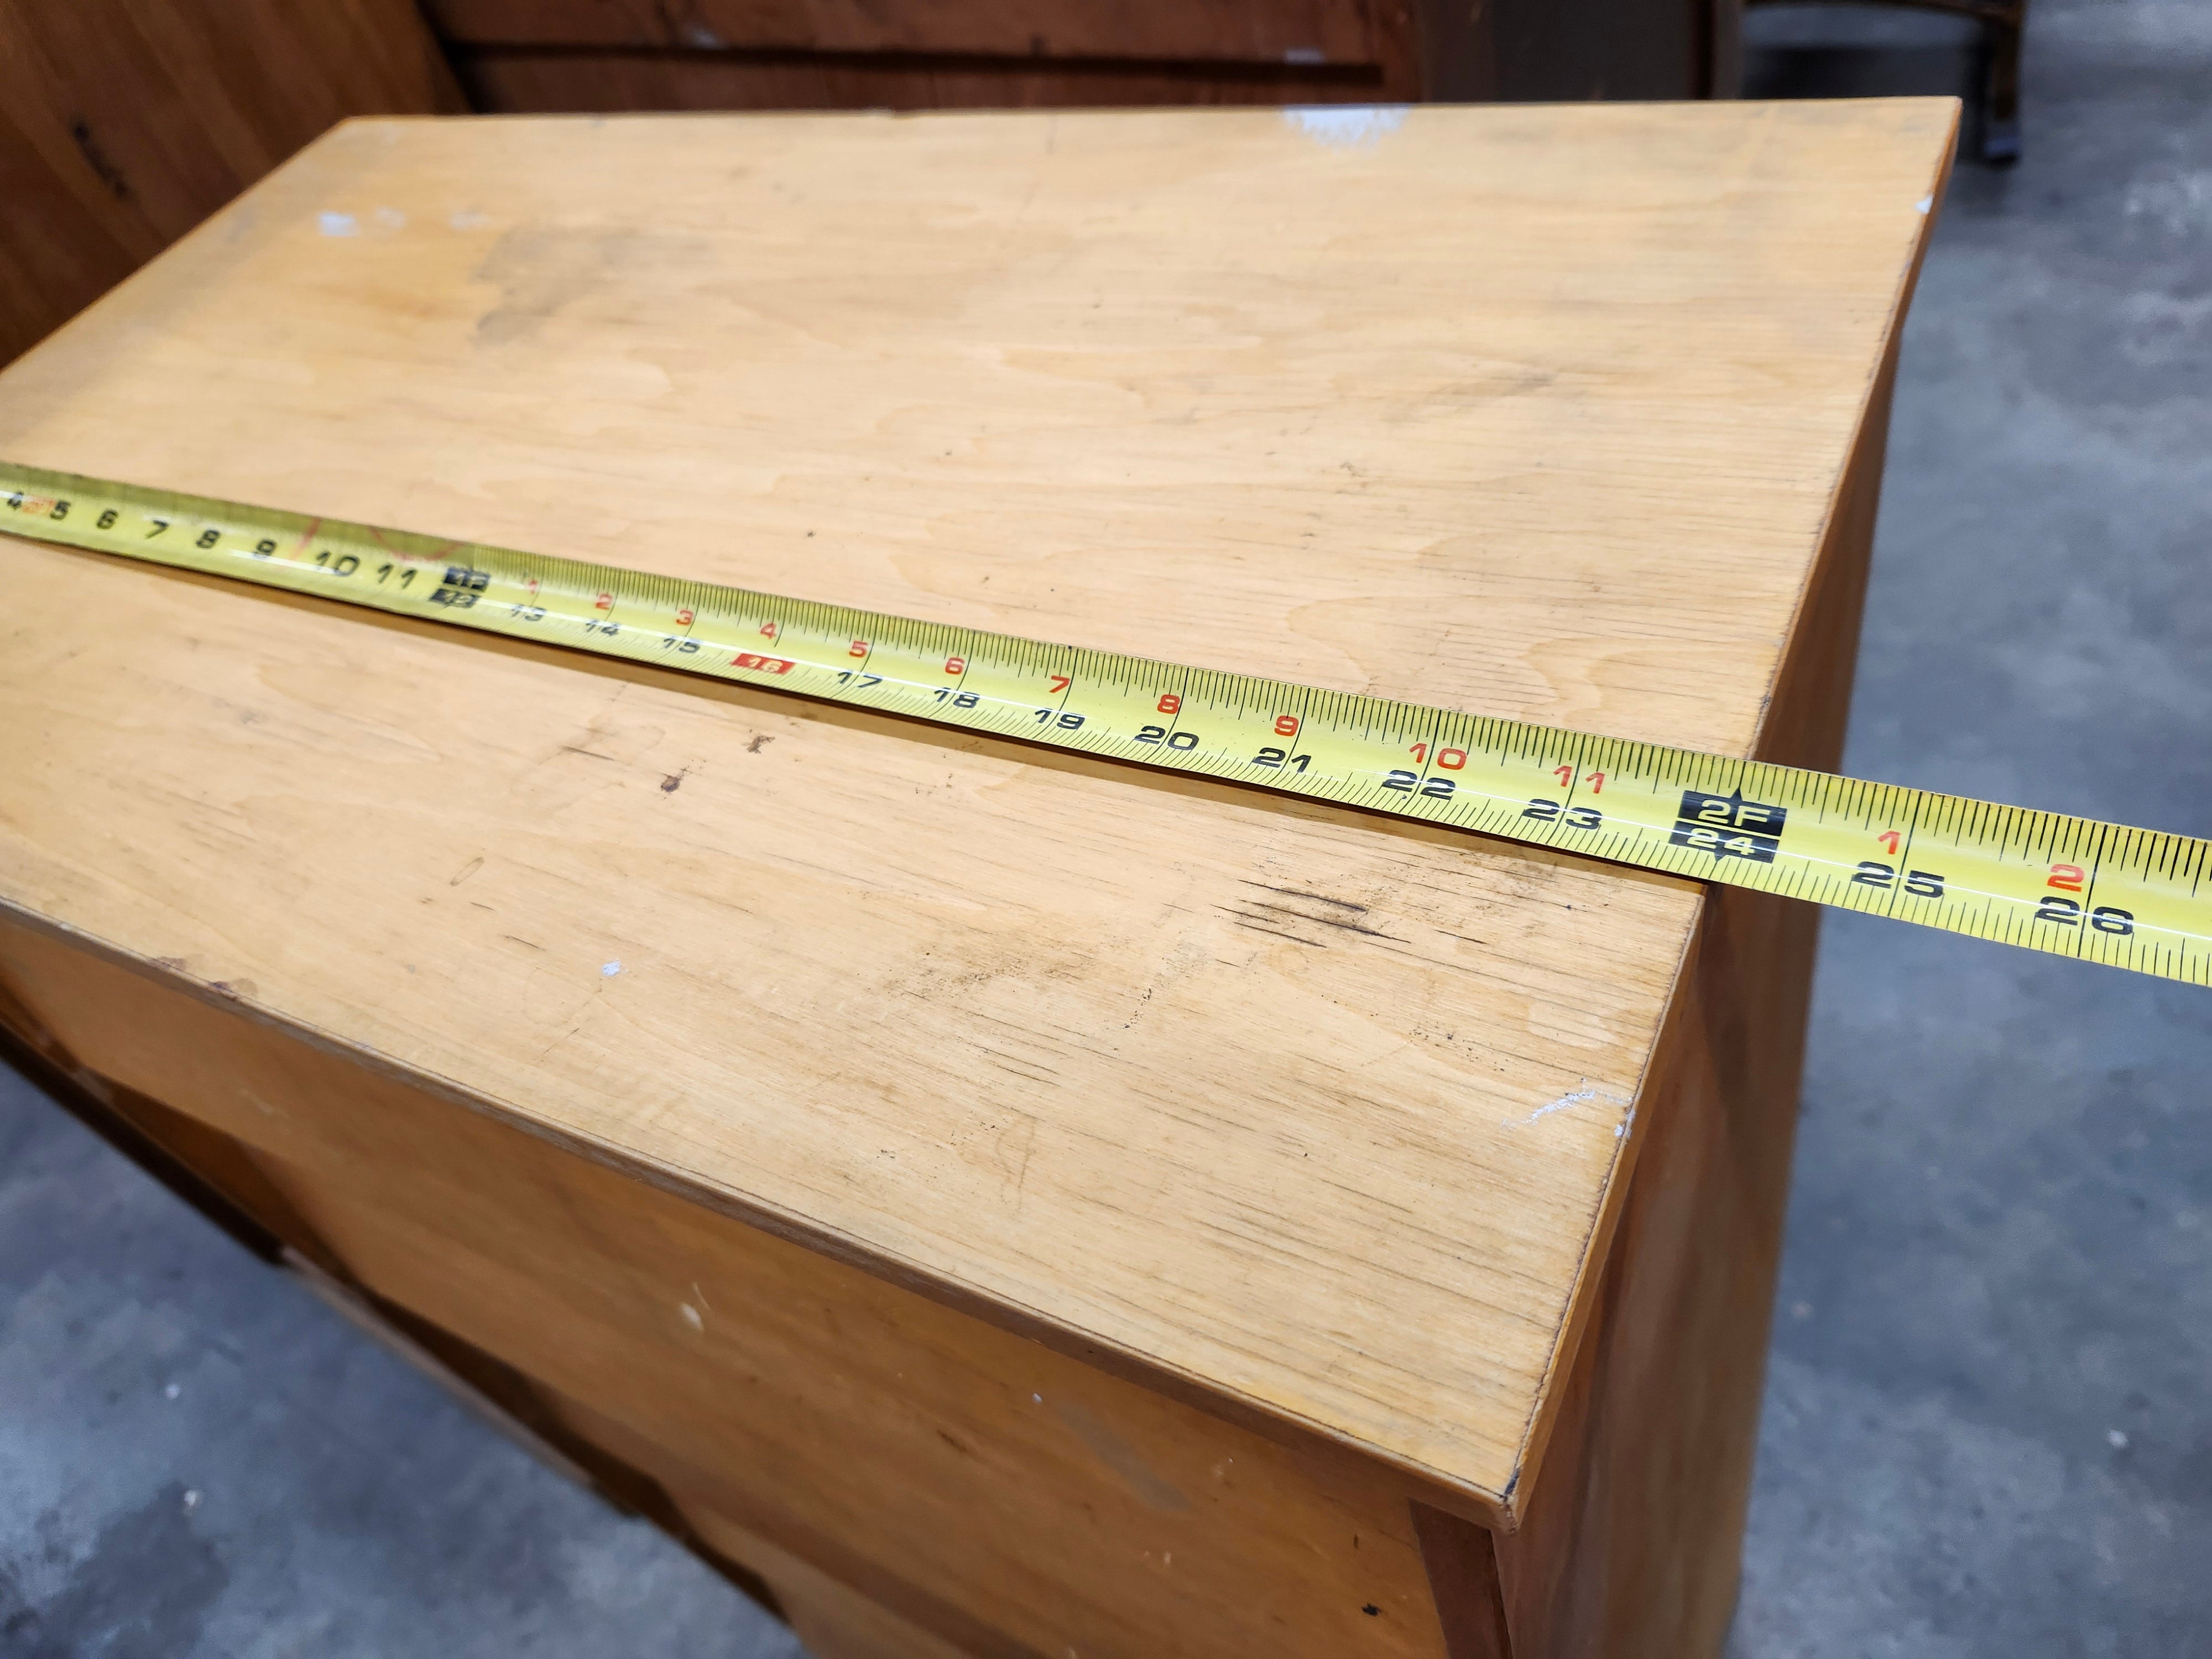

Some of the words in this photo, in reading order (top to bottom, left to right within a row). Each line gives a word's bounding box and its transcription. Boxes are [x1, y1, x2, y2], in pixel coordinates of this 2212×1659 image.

[50, 499, 71, 520] 5
[95, 508, 119, 530] 6
[145, 518, 169, 540] 7
[196, 529, 221, 549] 8
[252, 539, 277, 560] 9
[316, 550, 361, 577] 10
[377, 563, 417, 589] 11
[529, 580, 538, 596] 1
[595, 593, 613, 610] 2
[510, 604, 547, 622] 13
[676, 609, 695, 626] 3
[586, 619, 620, 637] 14
[760, 623, 777, 640] 4
[664, 635, 701, 654] 15
[849, 640, 869, 658] 5
[747, 656, 784, 674] 16
[945, 657, 966, 675] 6
[837, 670, 883, 688] 17
[1049, 675, 1071, 693] 7
[934, 687, 980, 708] 18
[1157, 694, 1181, 714] 8
[1034, 708, 1086, 730] 19
[1274, 715, 1299, 737] 9
[1134, 726, 1200, 751] 20
[1252, 747, 1312, 773] 21
[1409, 743, 1467, 770] 10
[1383, 769, 1456, 800] 22
[1553, 765, 1605, 794] 11
[1522, 799, 1603, 830] 23
[1697, 800, 1771, 827] 2F
[1686, 828, 1756, 855] 24
[1878, 831, 1901, 855] 1
[1851, 861, 1945, 898] 25
[2047, 864, 2085, 892] 2
[2035, 896, 2134, 935] 26
